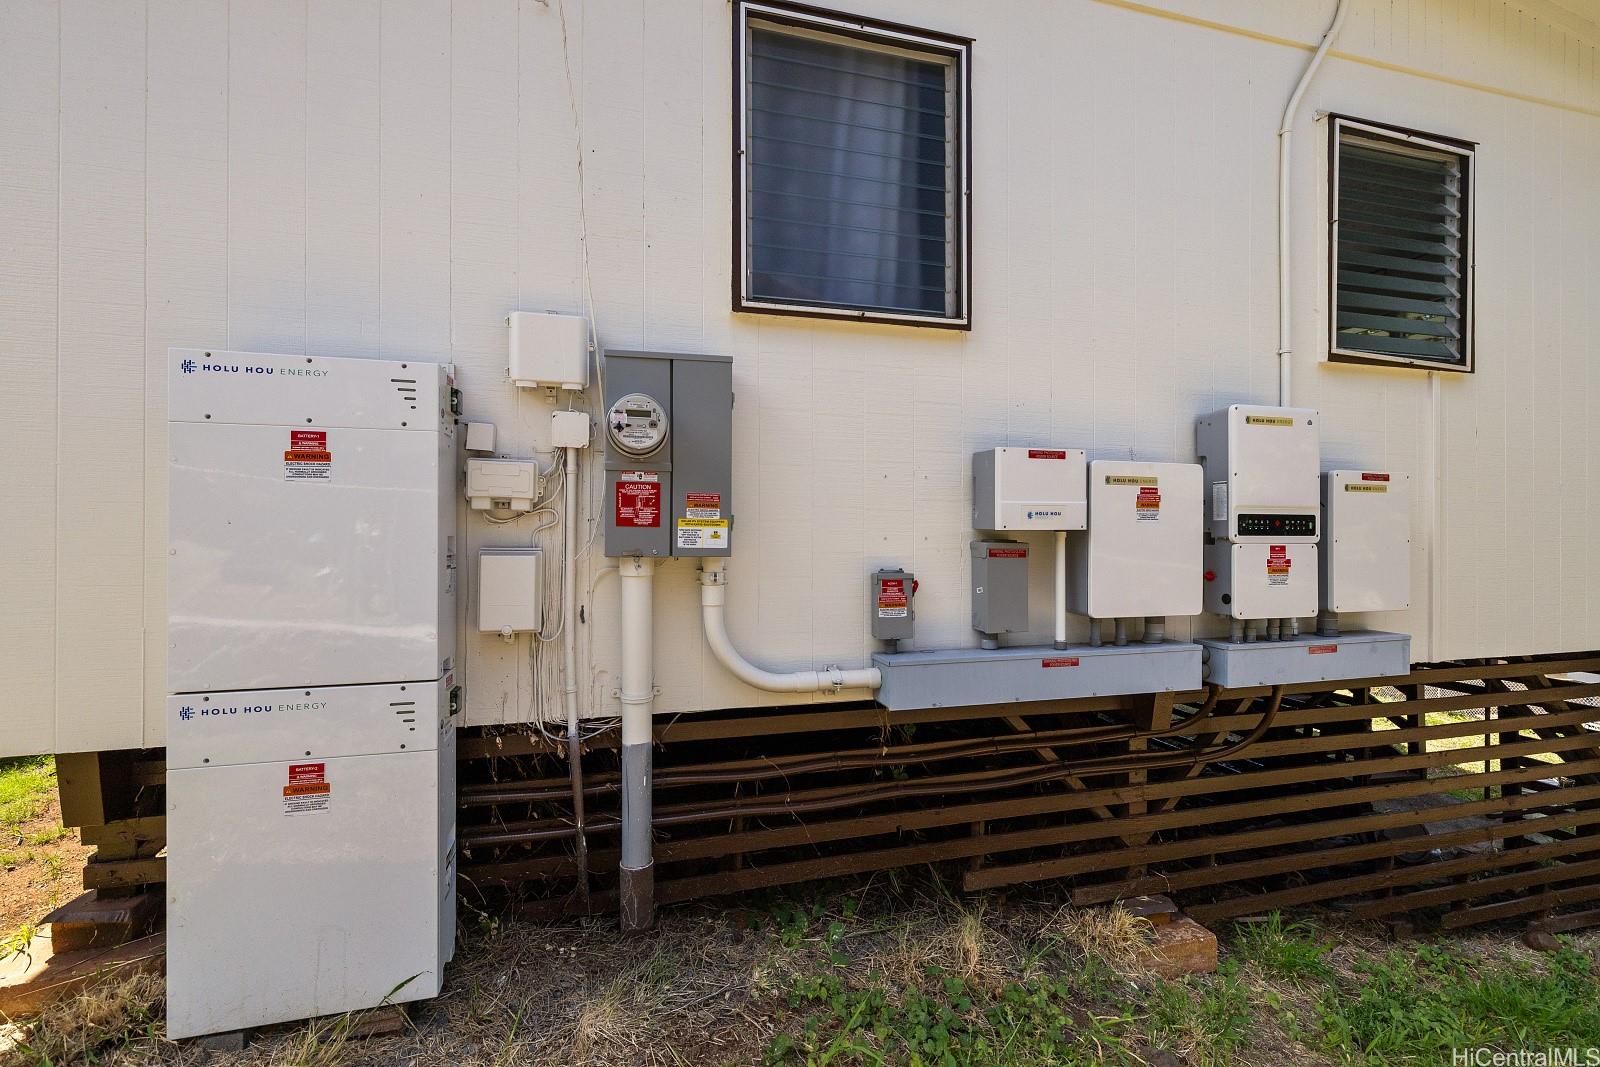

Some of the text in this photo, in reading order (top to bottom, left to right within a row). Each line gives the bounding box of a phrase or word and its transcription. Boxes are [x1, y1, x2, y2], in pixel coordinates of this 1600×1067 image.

[202, 364, 329, 377] HOLU HOU ENERGY
[201, 702, 328, 717] HOLU HOU ENERGY
